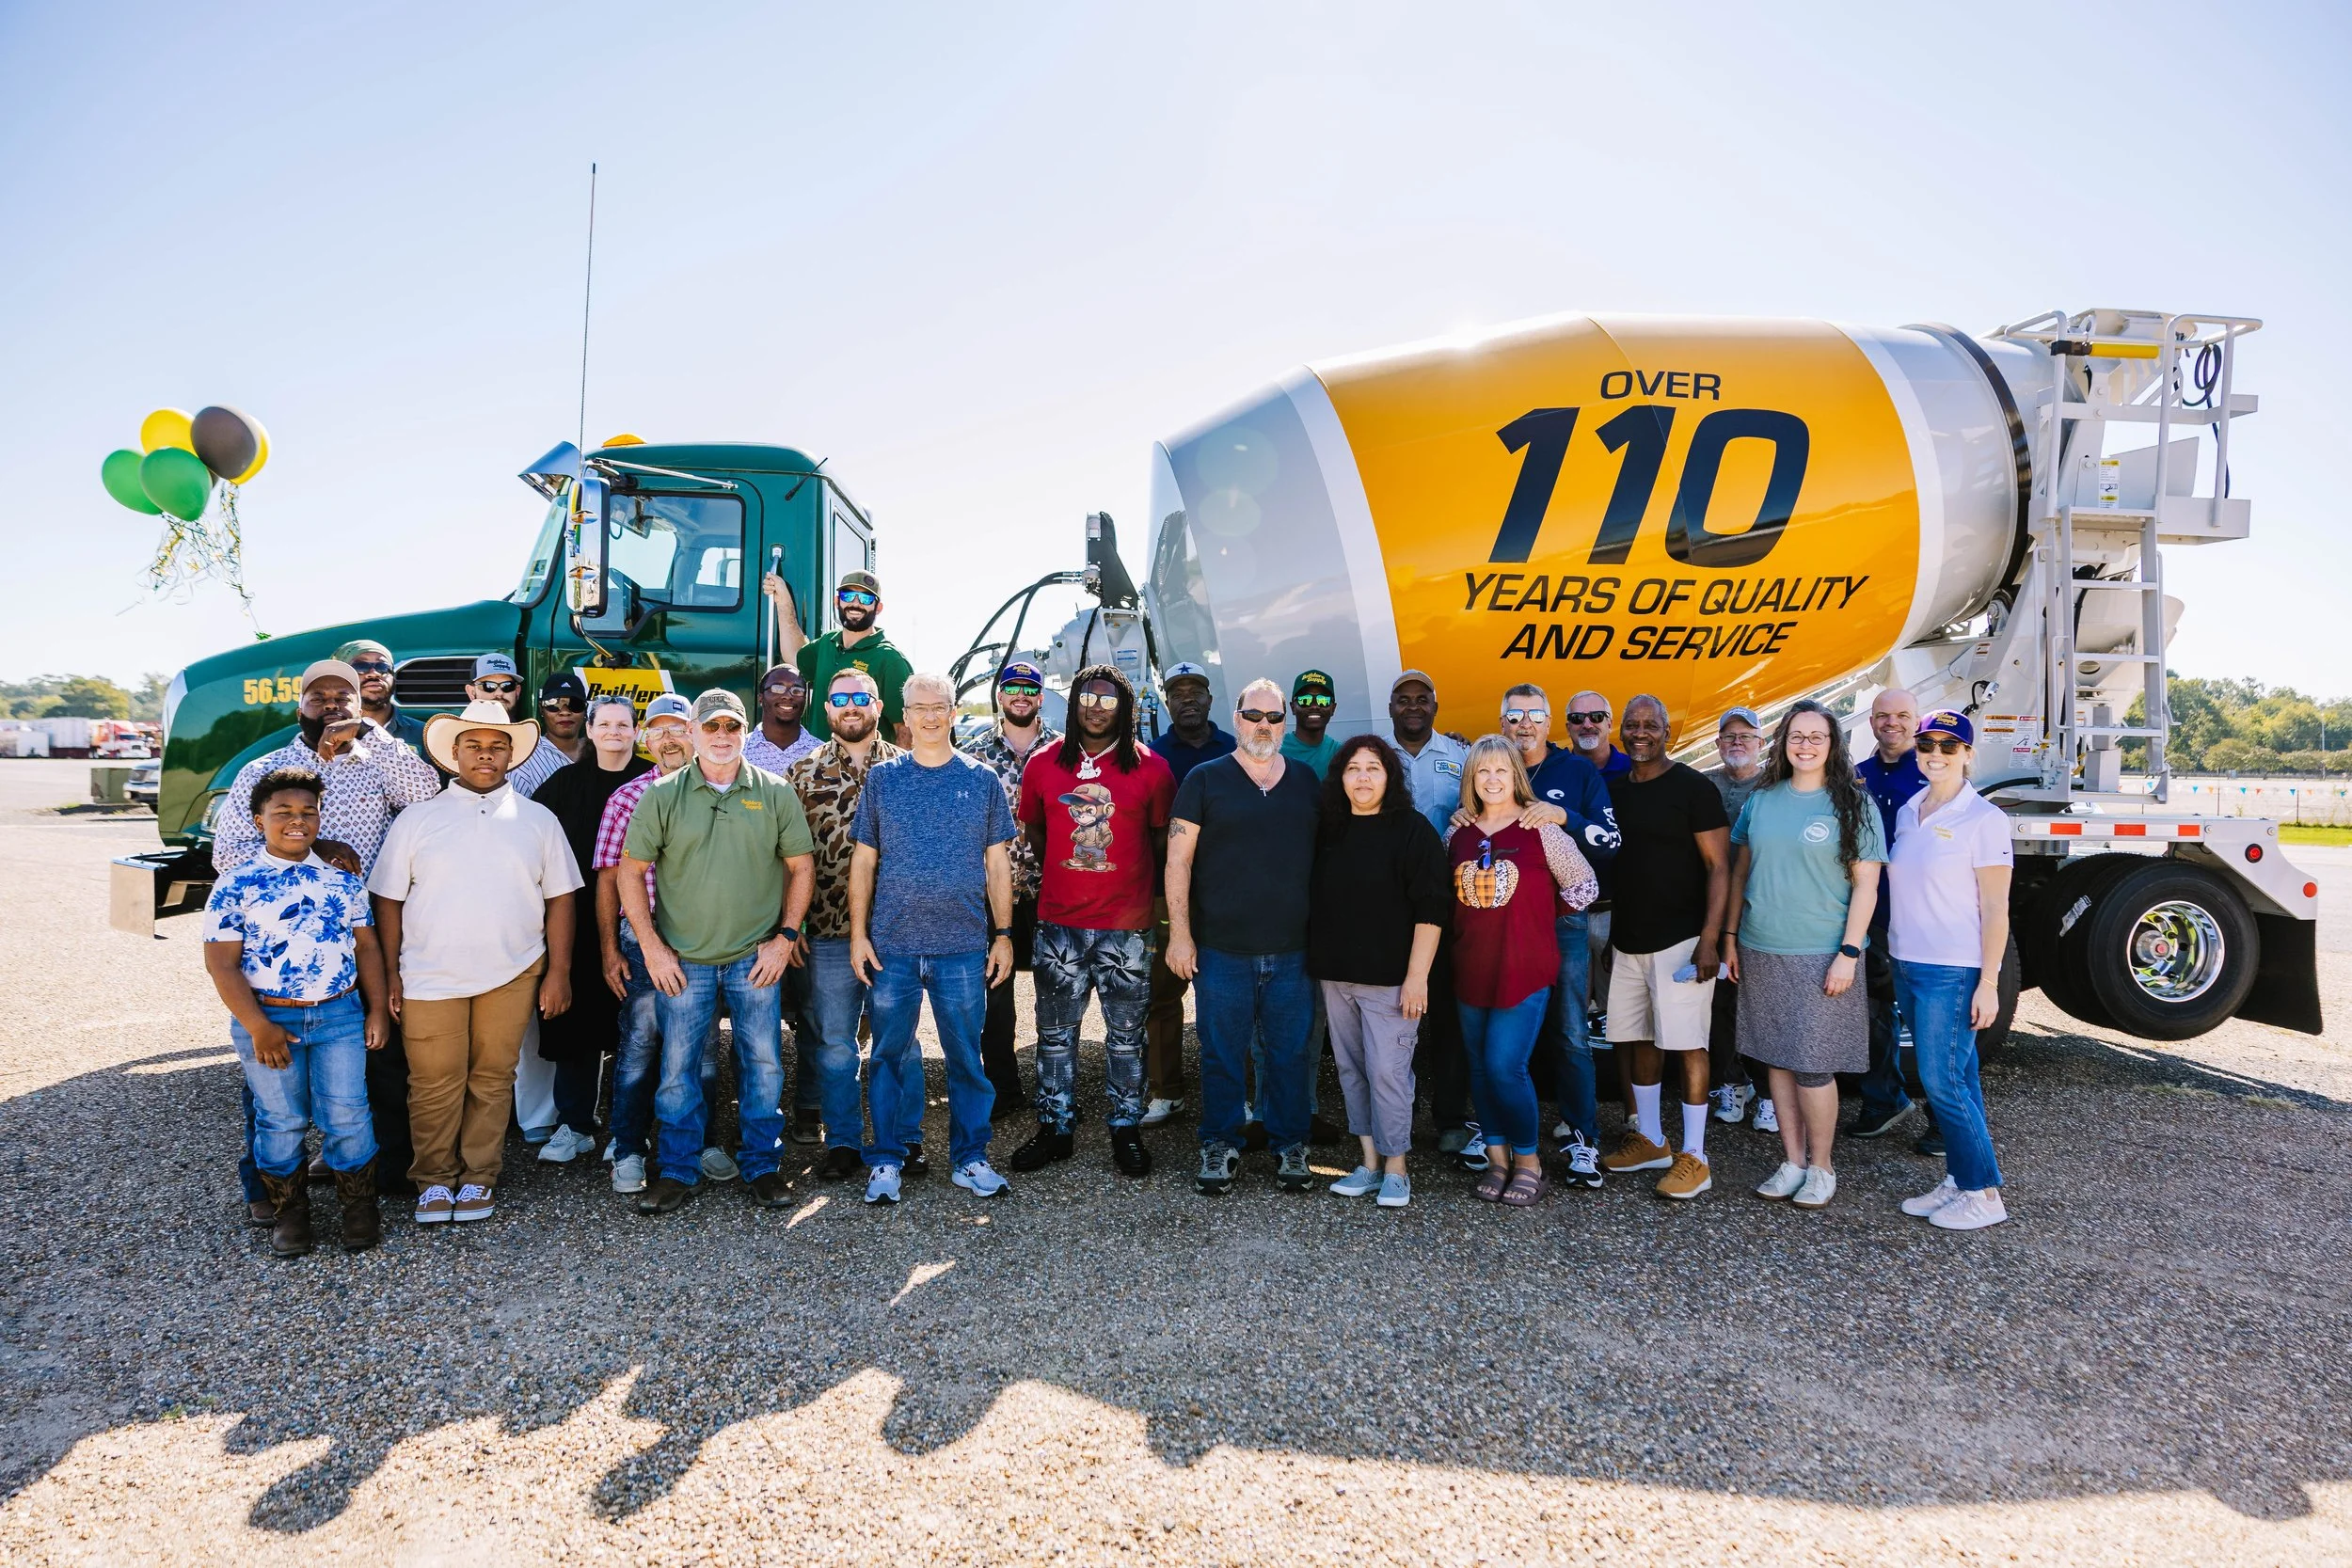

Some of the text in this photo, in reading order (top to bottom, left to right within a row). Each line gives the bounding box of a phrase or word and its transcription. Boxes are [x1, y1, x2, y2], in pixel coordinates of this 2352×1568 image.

[1600, 370, 1722, 401] OVER
[1487, 404, 1810, 569] 110
[1465, 573, 1870, 615] YEARS OF QUALITY
[1500, 622, 1799, 660] AND SERVICE
[587, 683, 674, 703] Builder
